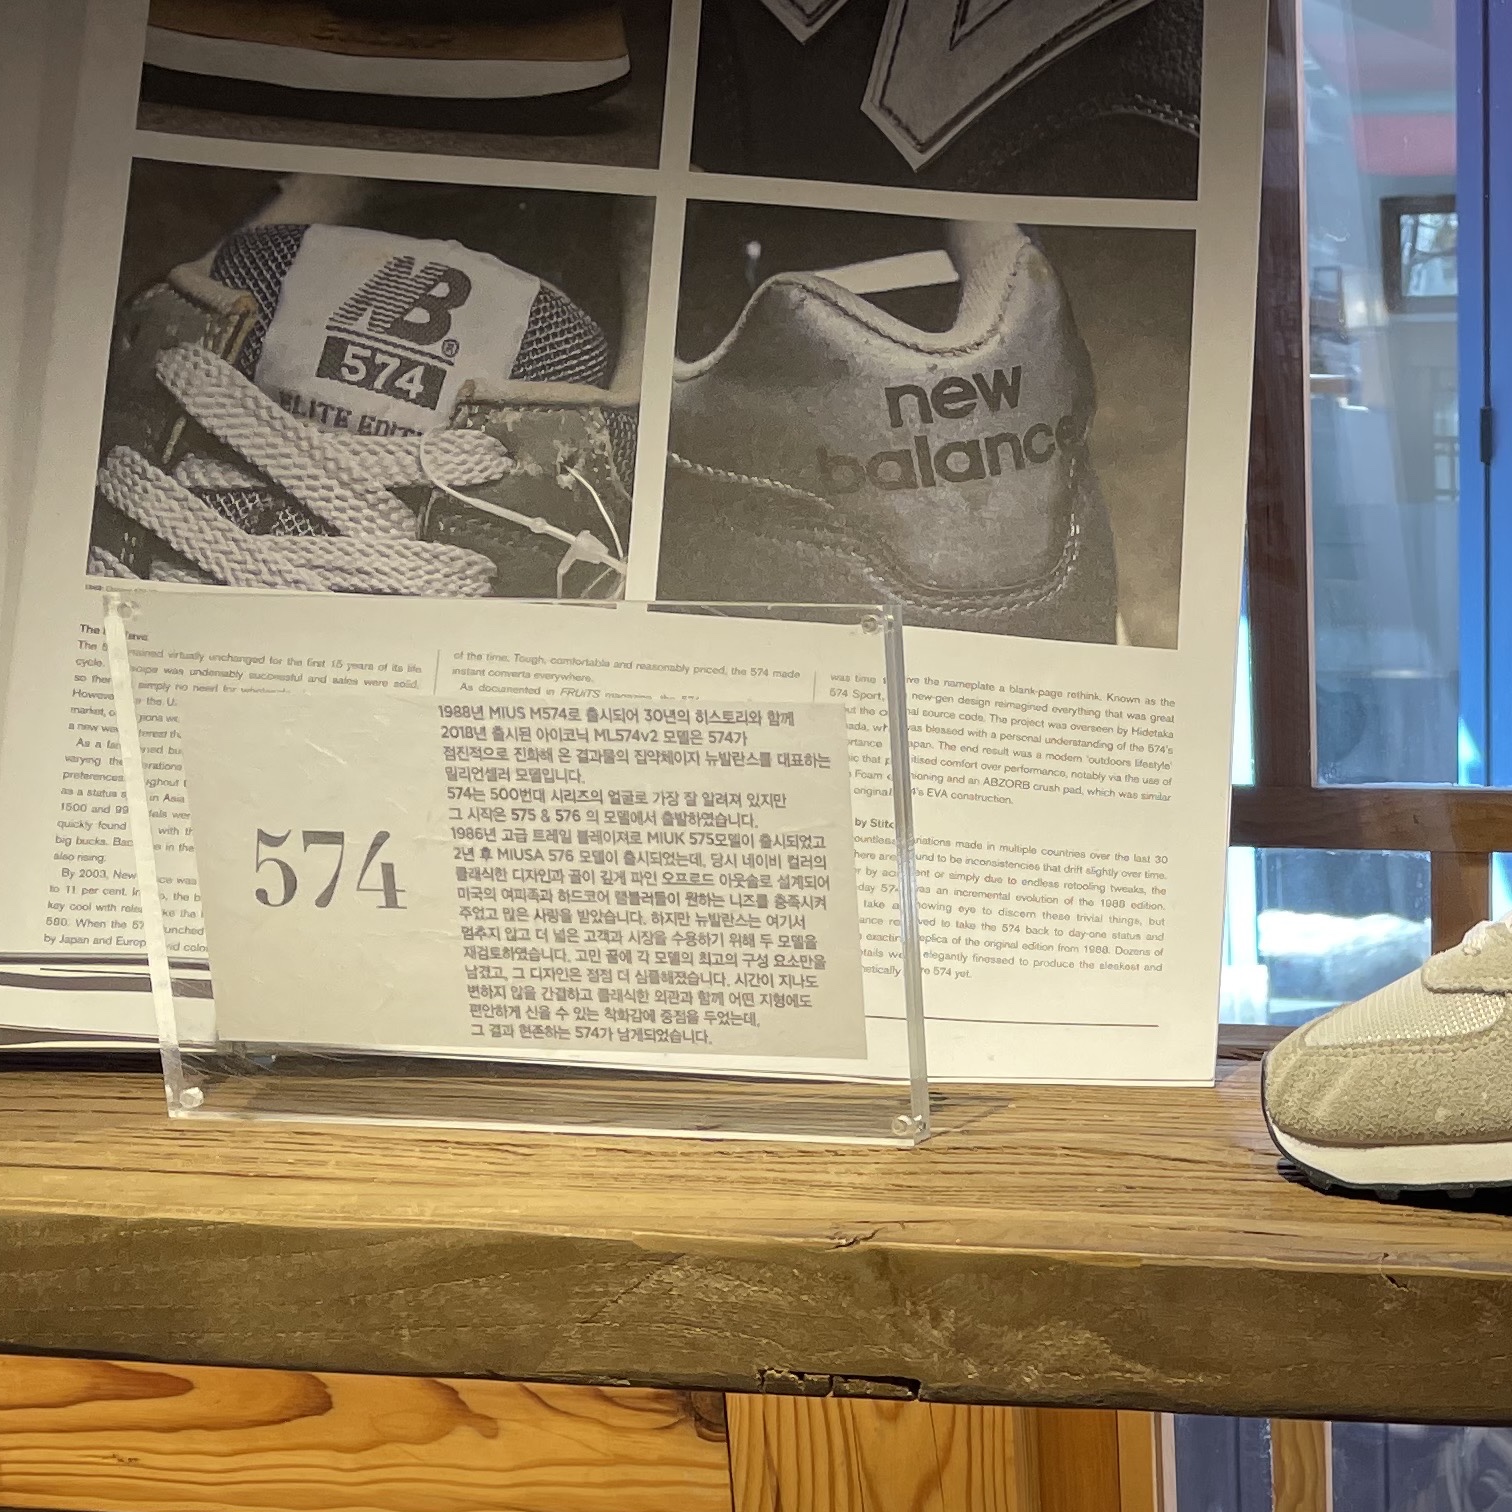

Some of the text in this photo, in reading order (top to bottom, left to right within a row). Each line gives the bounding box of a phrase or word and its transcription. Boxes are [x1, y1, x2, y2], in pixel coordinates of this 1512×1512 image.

[340, 342, 425, 400] 574
[884, 364, 1022, 428] new
[816, 414, 1088, 494] balance
[613, 659, 633, 669] and
[731, 666, 747, 676] the
[750, 667, 769, 678] 574
[772, 668, 801, 679] made
[924, 677, 940, 685] the
[943, 679, 995, 692] nameplate
[1009, 684, 1063, 699] blank-page
[1106, 692, 1141, 705] Known
[1160, 698, 1176, 707] the
[438, 705, 483, 721] 1988년
[529, 707, 582, 722] M574로
[586, 707, 639, 723] 출시되어
[644, 709, 690, 725] 30년의
[695, 710, 762, 726] 히스토리와
[767, 710, 794, 726] 함께
[441, 725, 747, 746] 2018년 출시된 아이코닉 ML574v2 모델은 574가
[447, 787, 486, 802] 574는
[490, 788, 545, 803] 500번대
[551, 789, 603, 804] 시리즈의
[653, 791, 679, 806] 가장
[684, 791, 697, 807] 잘
[747, 793, 786, 808] 있지만
[449, 808, 462, 820] 그
[468, 807, 506, 822] 시작은
[511, 808, 536, 821] 575
[541, 808, 551, 823] &
[555, 809, 581, 822] 576
[586, 810, 599, 825] 의
[604, 810, 656, 826] 모델에서
[255, 828, 407, 910] 574
